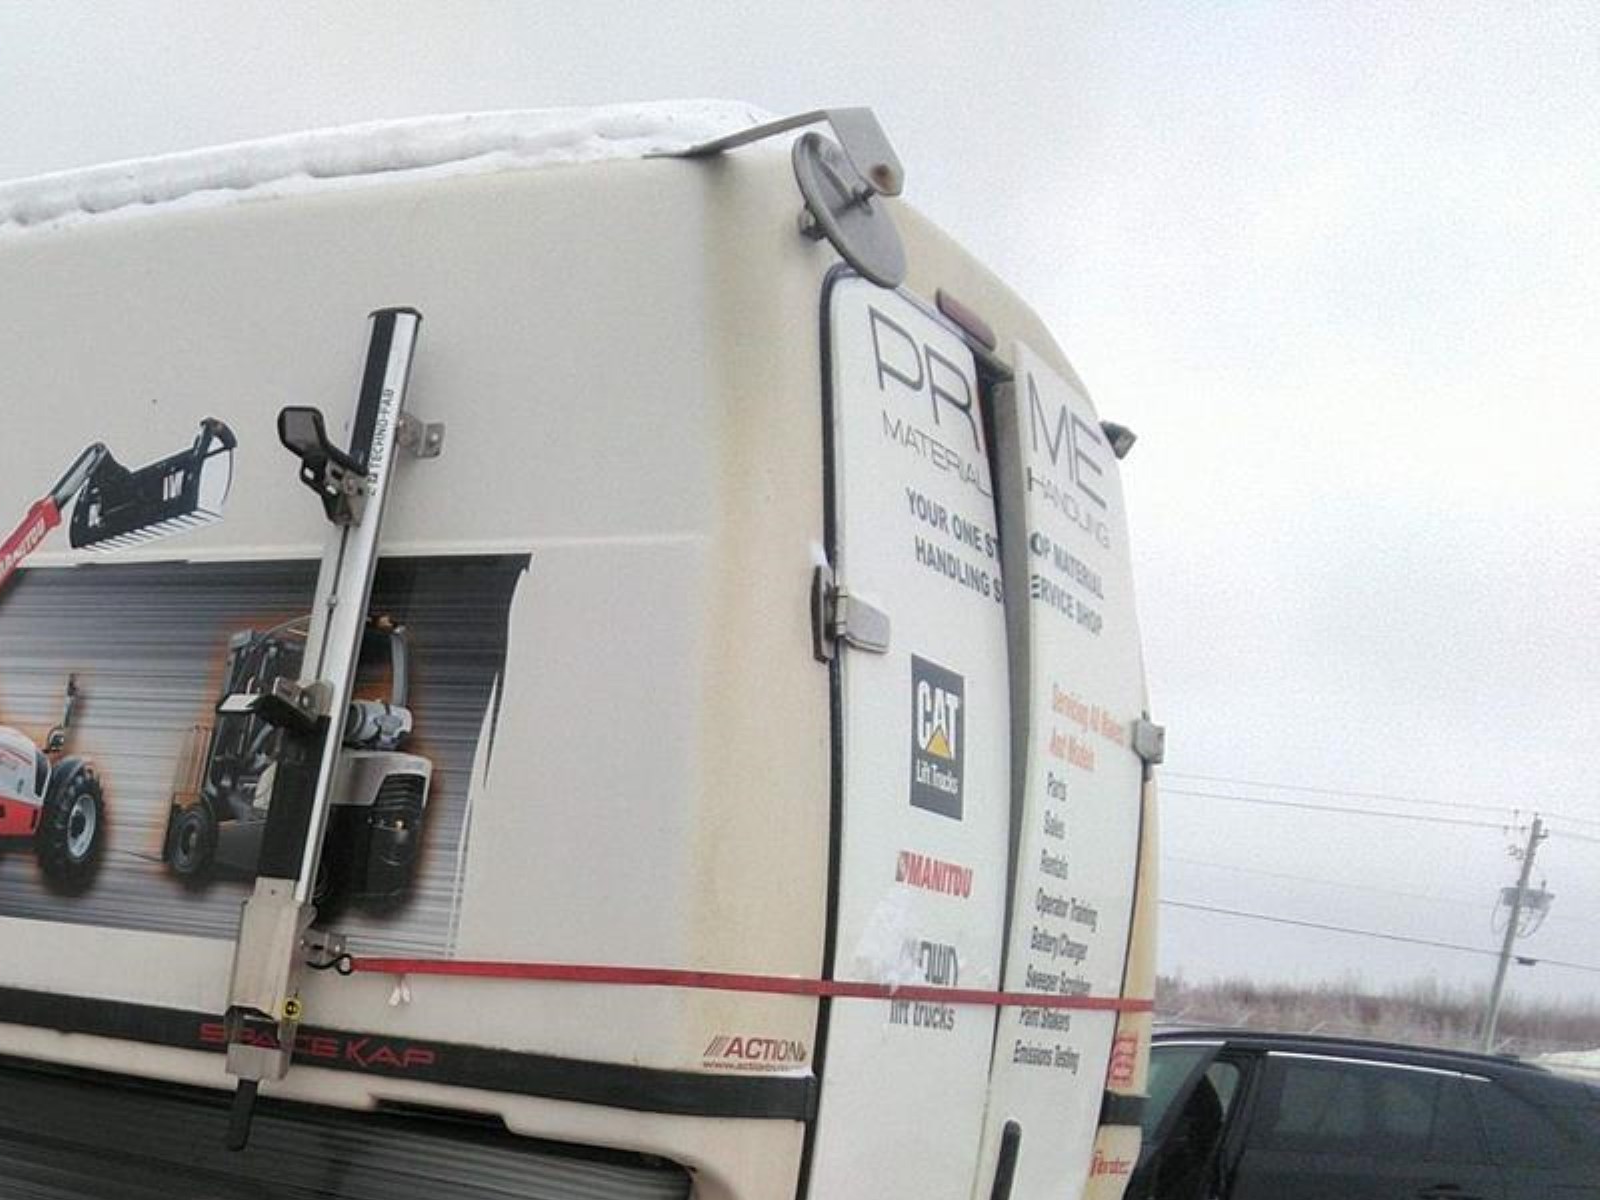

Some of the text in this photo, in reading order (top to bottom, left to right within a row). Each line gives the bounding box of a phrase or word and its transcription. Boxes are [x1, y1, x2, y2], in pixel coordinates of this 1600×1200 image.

[883, 410, 995, 498] MATERIAL
[905, 486, 950, 534] YOUR
[952, 514, 983, 552] ONE
[1053, 543, 1104, 600] MATERIAL
[915, 535, 990, 597] HANDLING
[917, 680, 959, 760] CAT
[916, 758, 959, 794] Lift Trucks
[905, 853, 974, 899] MANITOU
[913, 1000, 955, 1030] trucks
